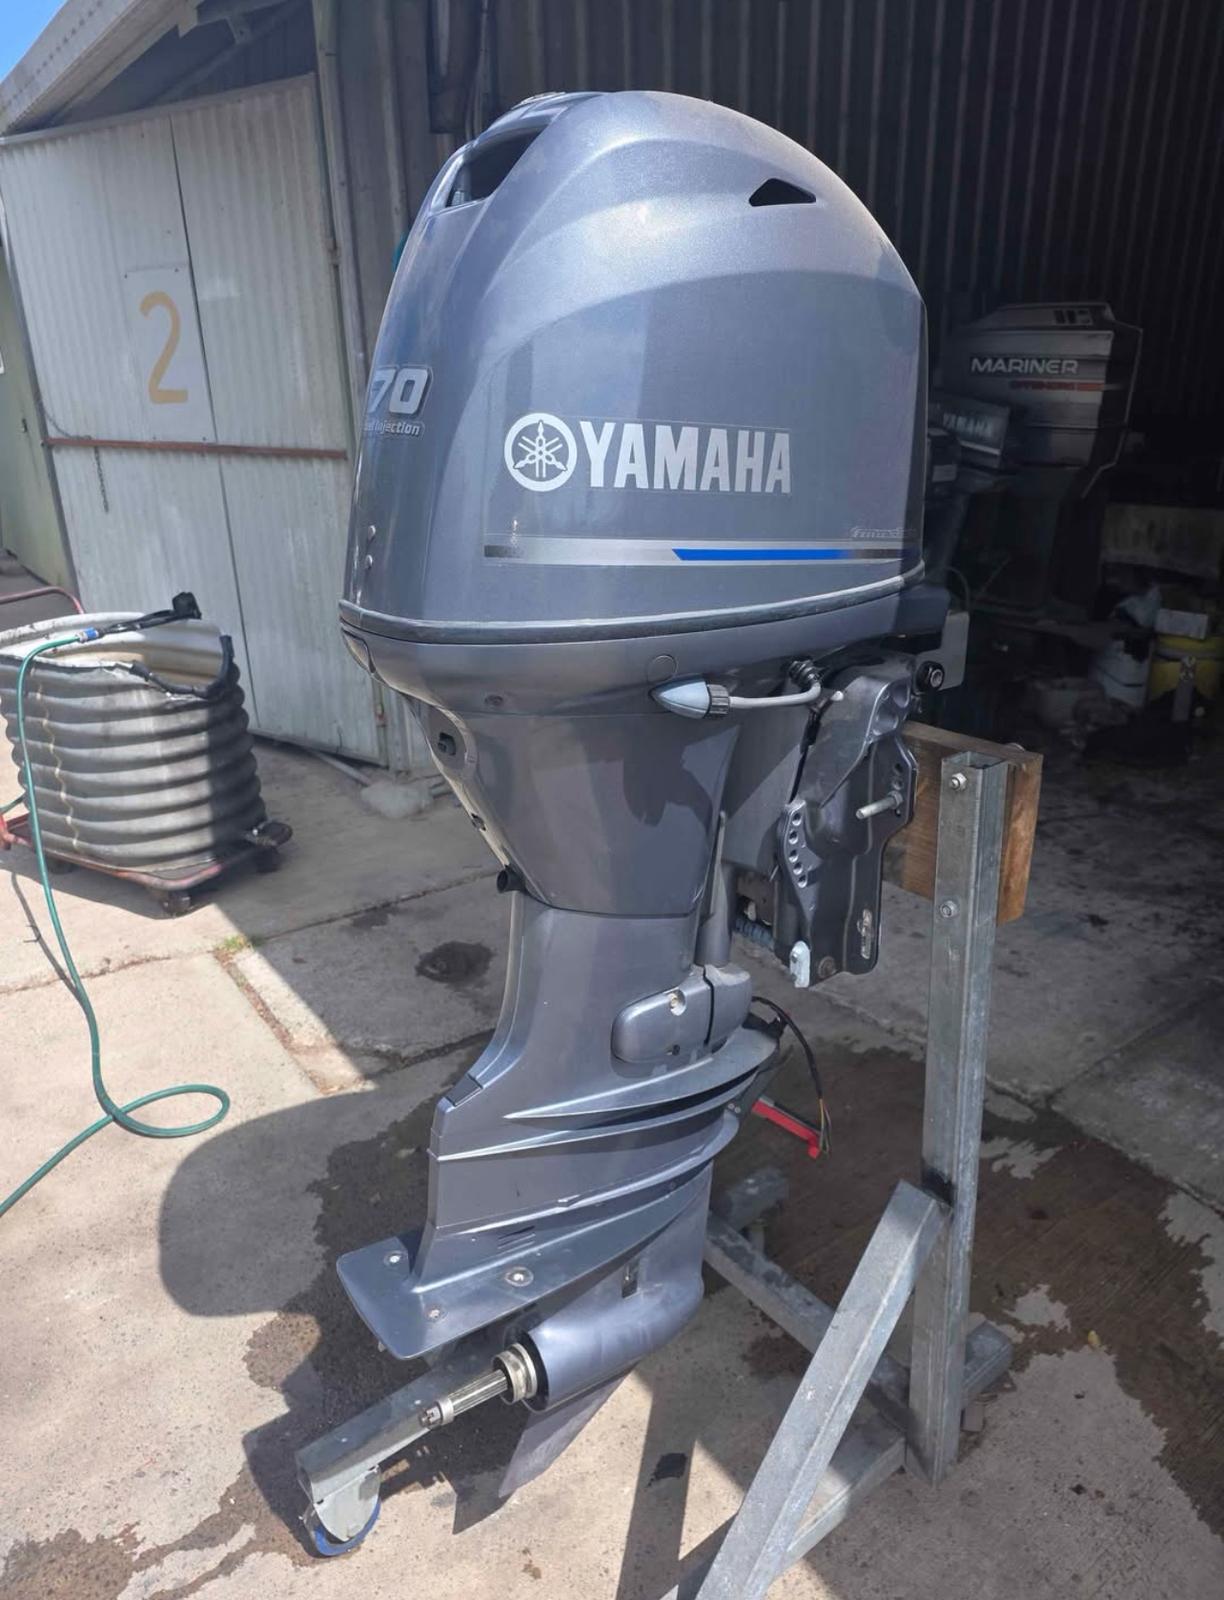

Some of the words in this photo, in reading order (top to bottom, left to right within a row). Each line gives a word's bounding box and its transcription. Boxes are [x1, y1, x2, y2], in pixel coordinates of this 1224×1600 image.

[139, 290, 189, 404] 2
[971, 357, 1079, 375] MARINER
[579, 420, 792, 494] YAMAHA
